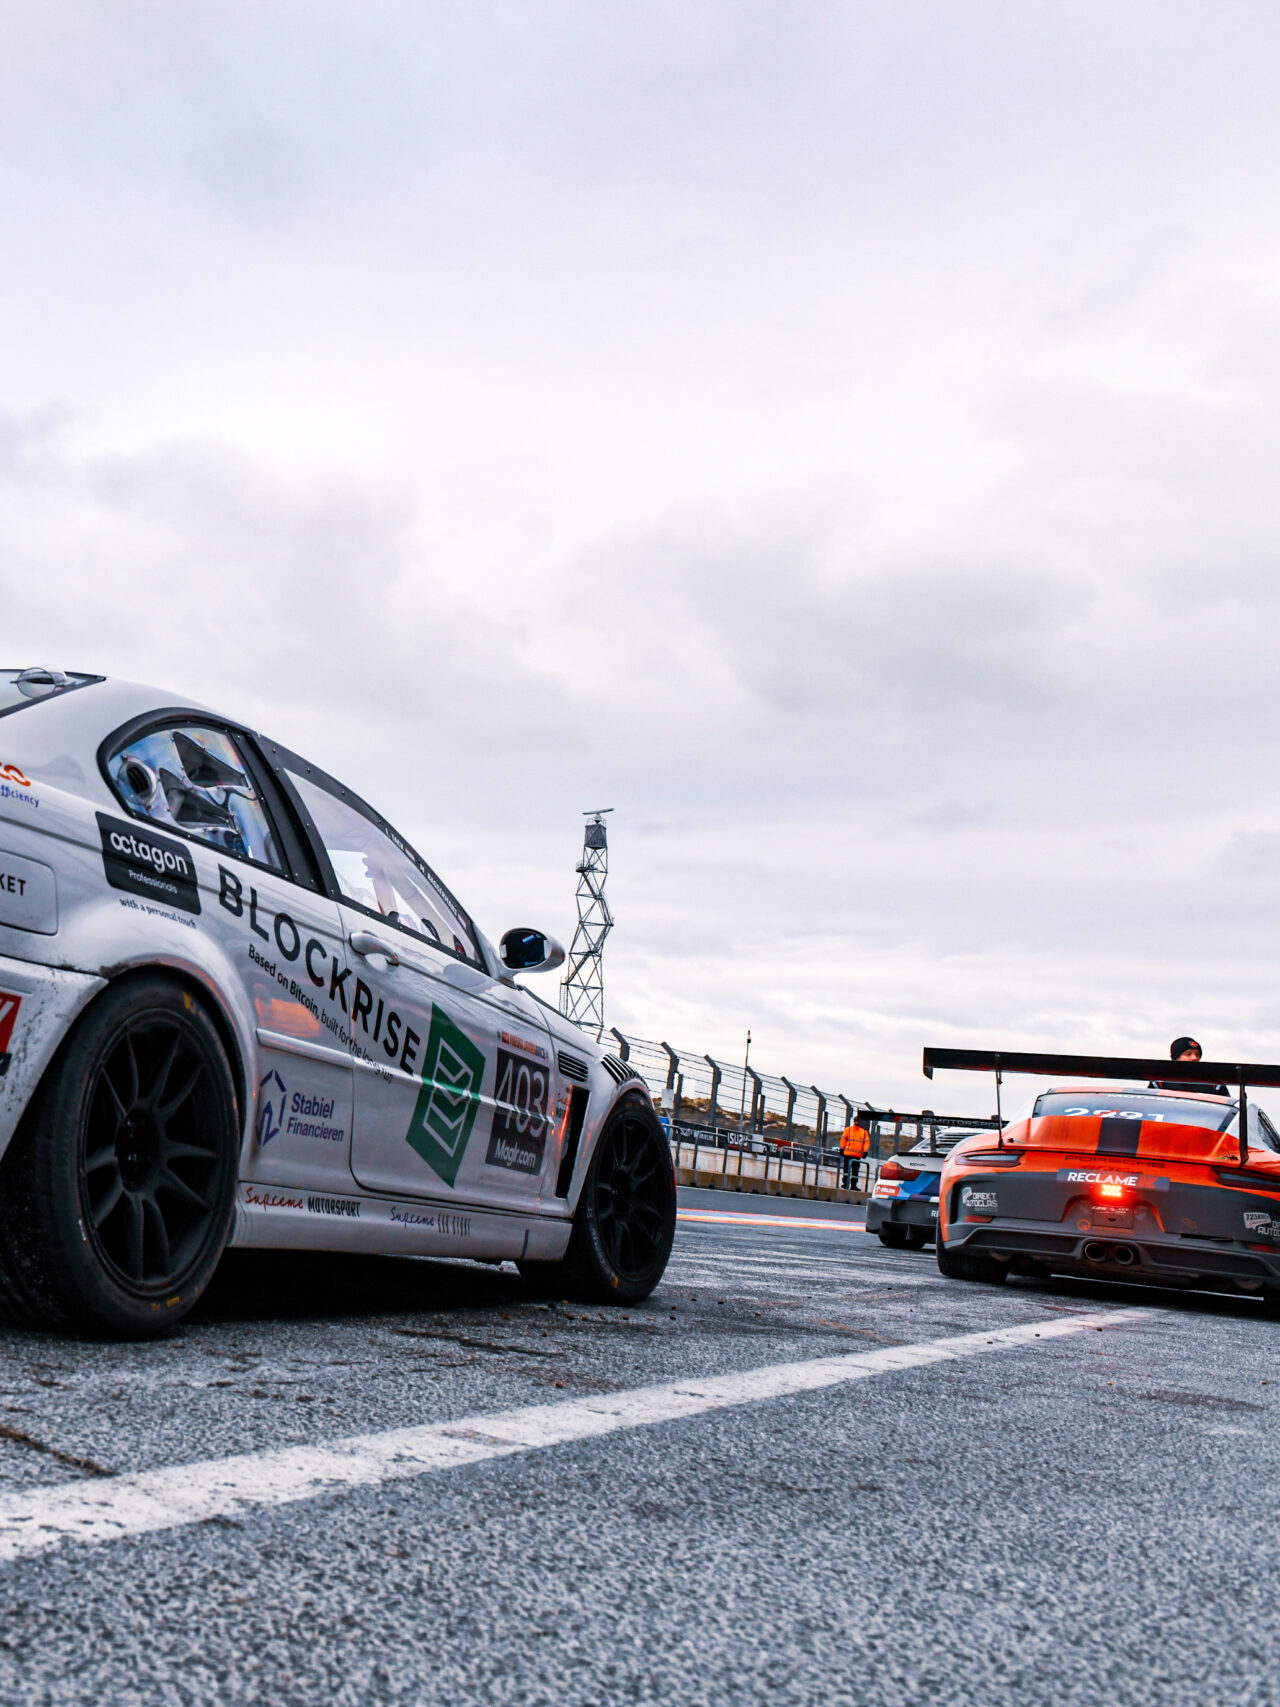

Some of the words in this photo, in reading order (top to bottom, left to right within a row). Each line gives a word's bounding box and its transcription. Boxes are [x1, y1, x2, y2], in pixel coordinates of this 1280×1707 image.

[110, 832, 188, 875] octagon
[128, 869, 178, 895] Professionals
[217, 863, 421, 1078] BLOCKRISE
[248, 943, 277, 978] Based
[276, 972, 289, 990] on
[290, 980, 320, 1020] Bitcoin,
[320, 1008, 340, 1034] built
[338, 1027, 350, 1046] for
[349, 1037, 362, 1057] the
[290, 1092, 335, 1120] Stabiel
[495, 1058, 546, 1139] 403
[286, 1118, 345, 1143] Financieren
[1064, 1154, 1166, 1169] PORSCHE
[244, 1186, 304, 1213] Supreme
[307, 1196, 361, 1218] MOTORSPORT
[389, 1206, 435, 1229] Supreme
